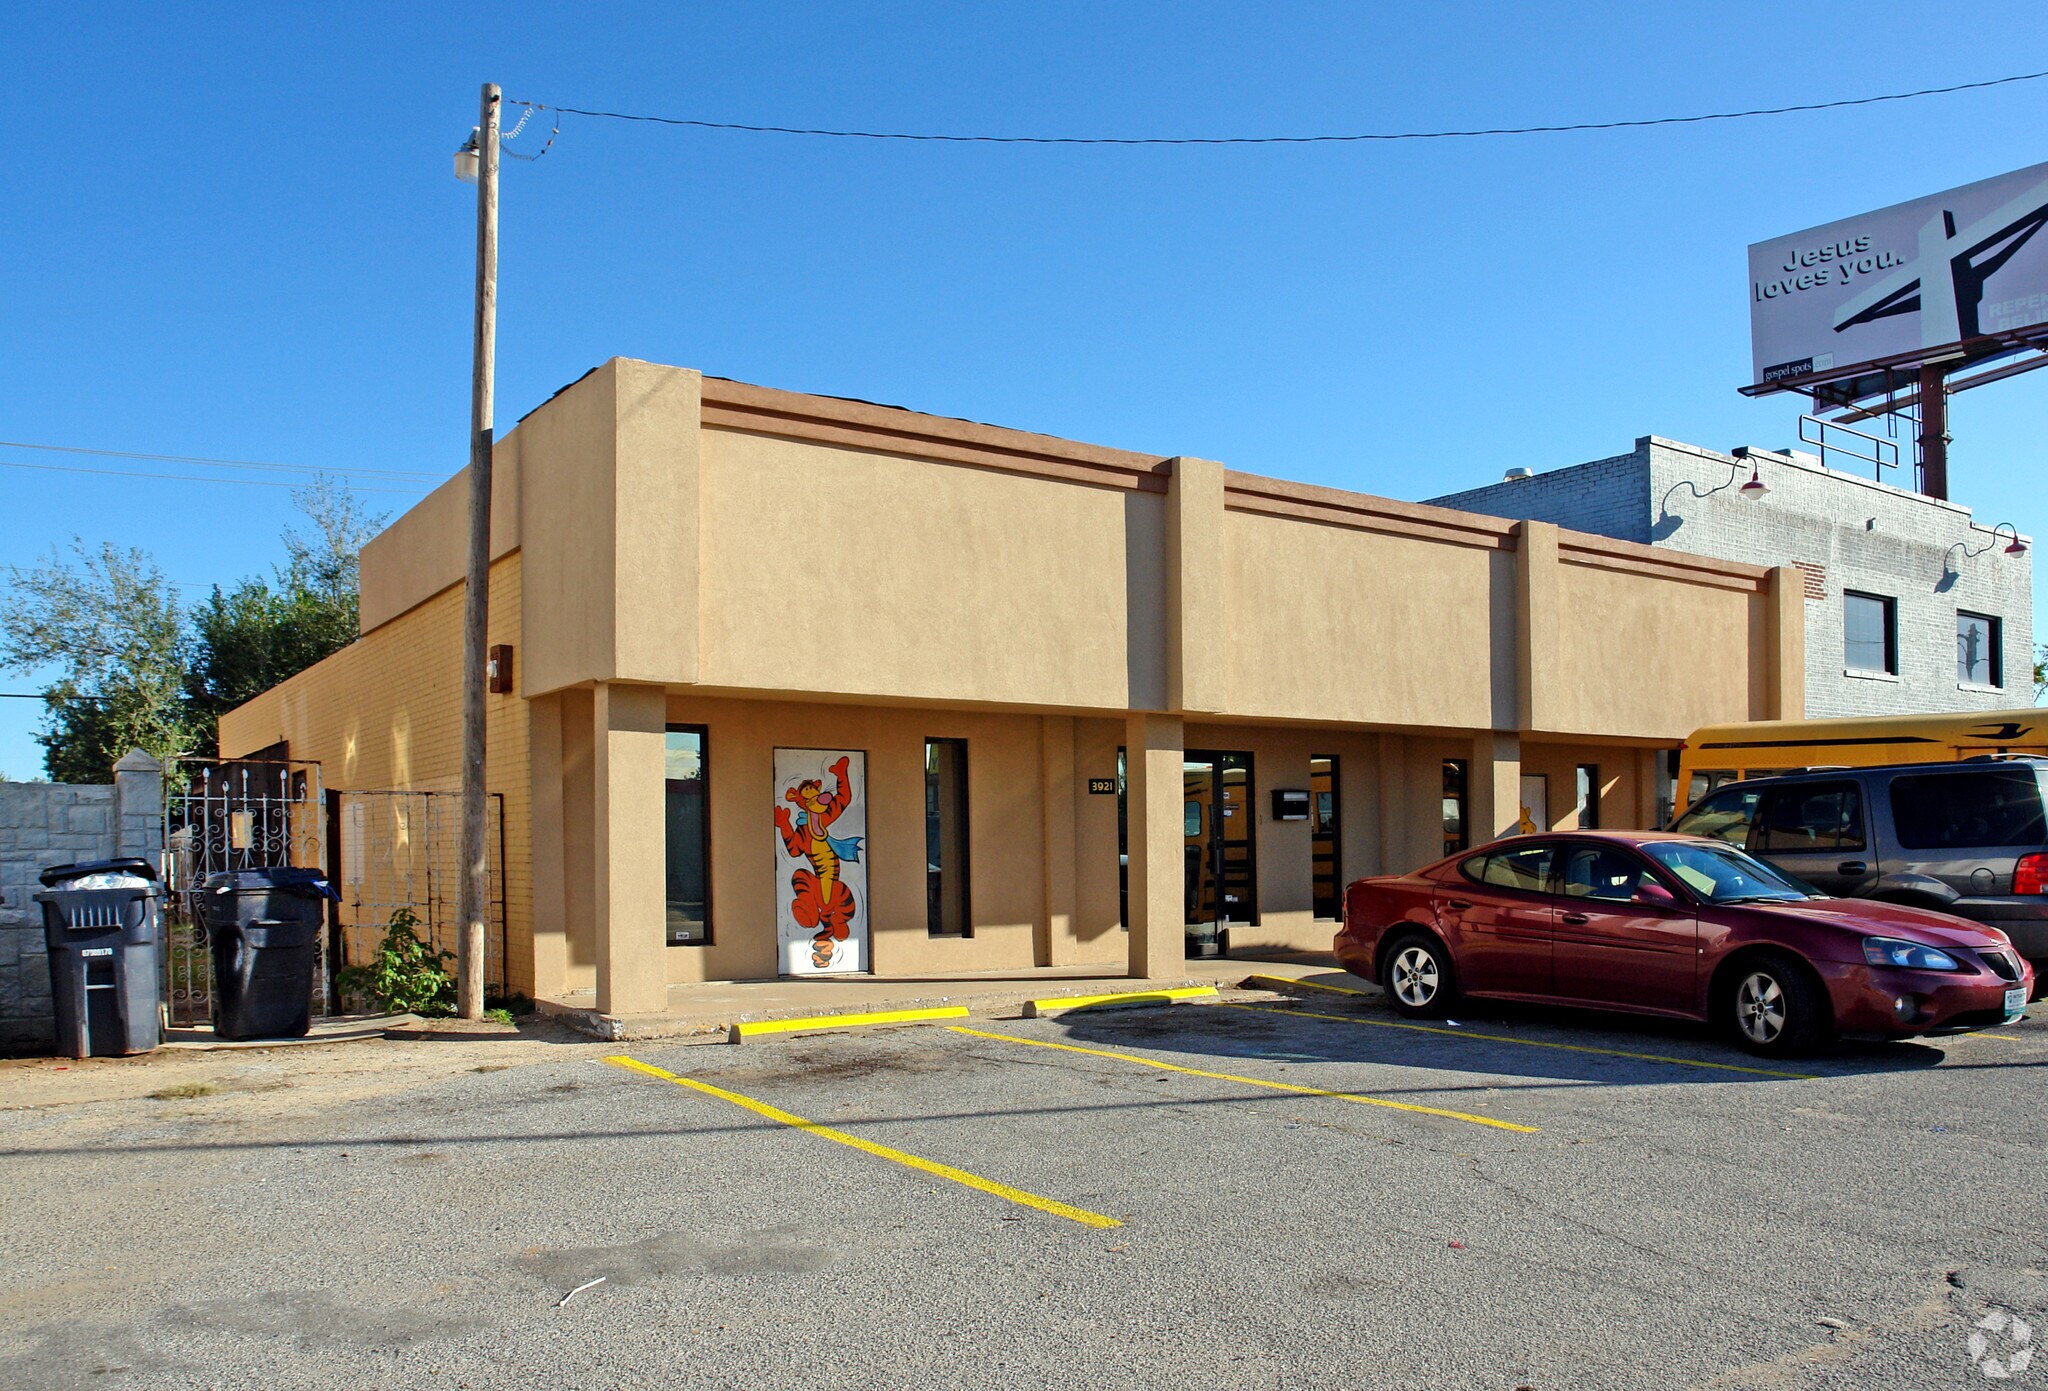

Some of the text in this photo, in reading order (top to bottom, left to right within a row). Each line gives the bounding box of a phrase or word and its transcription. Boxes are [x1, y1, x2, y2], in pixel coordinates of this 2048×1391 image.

[1782, 233, 1872, 272] Jesus
[1754, 250, 1906, 302] loves you.
[1765, 365, 1790, 382] gospel
[1791, 362, 1812, 376] spots
[1091, 781, 1113, 791] 3921
